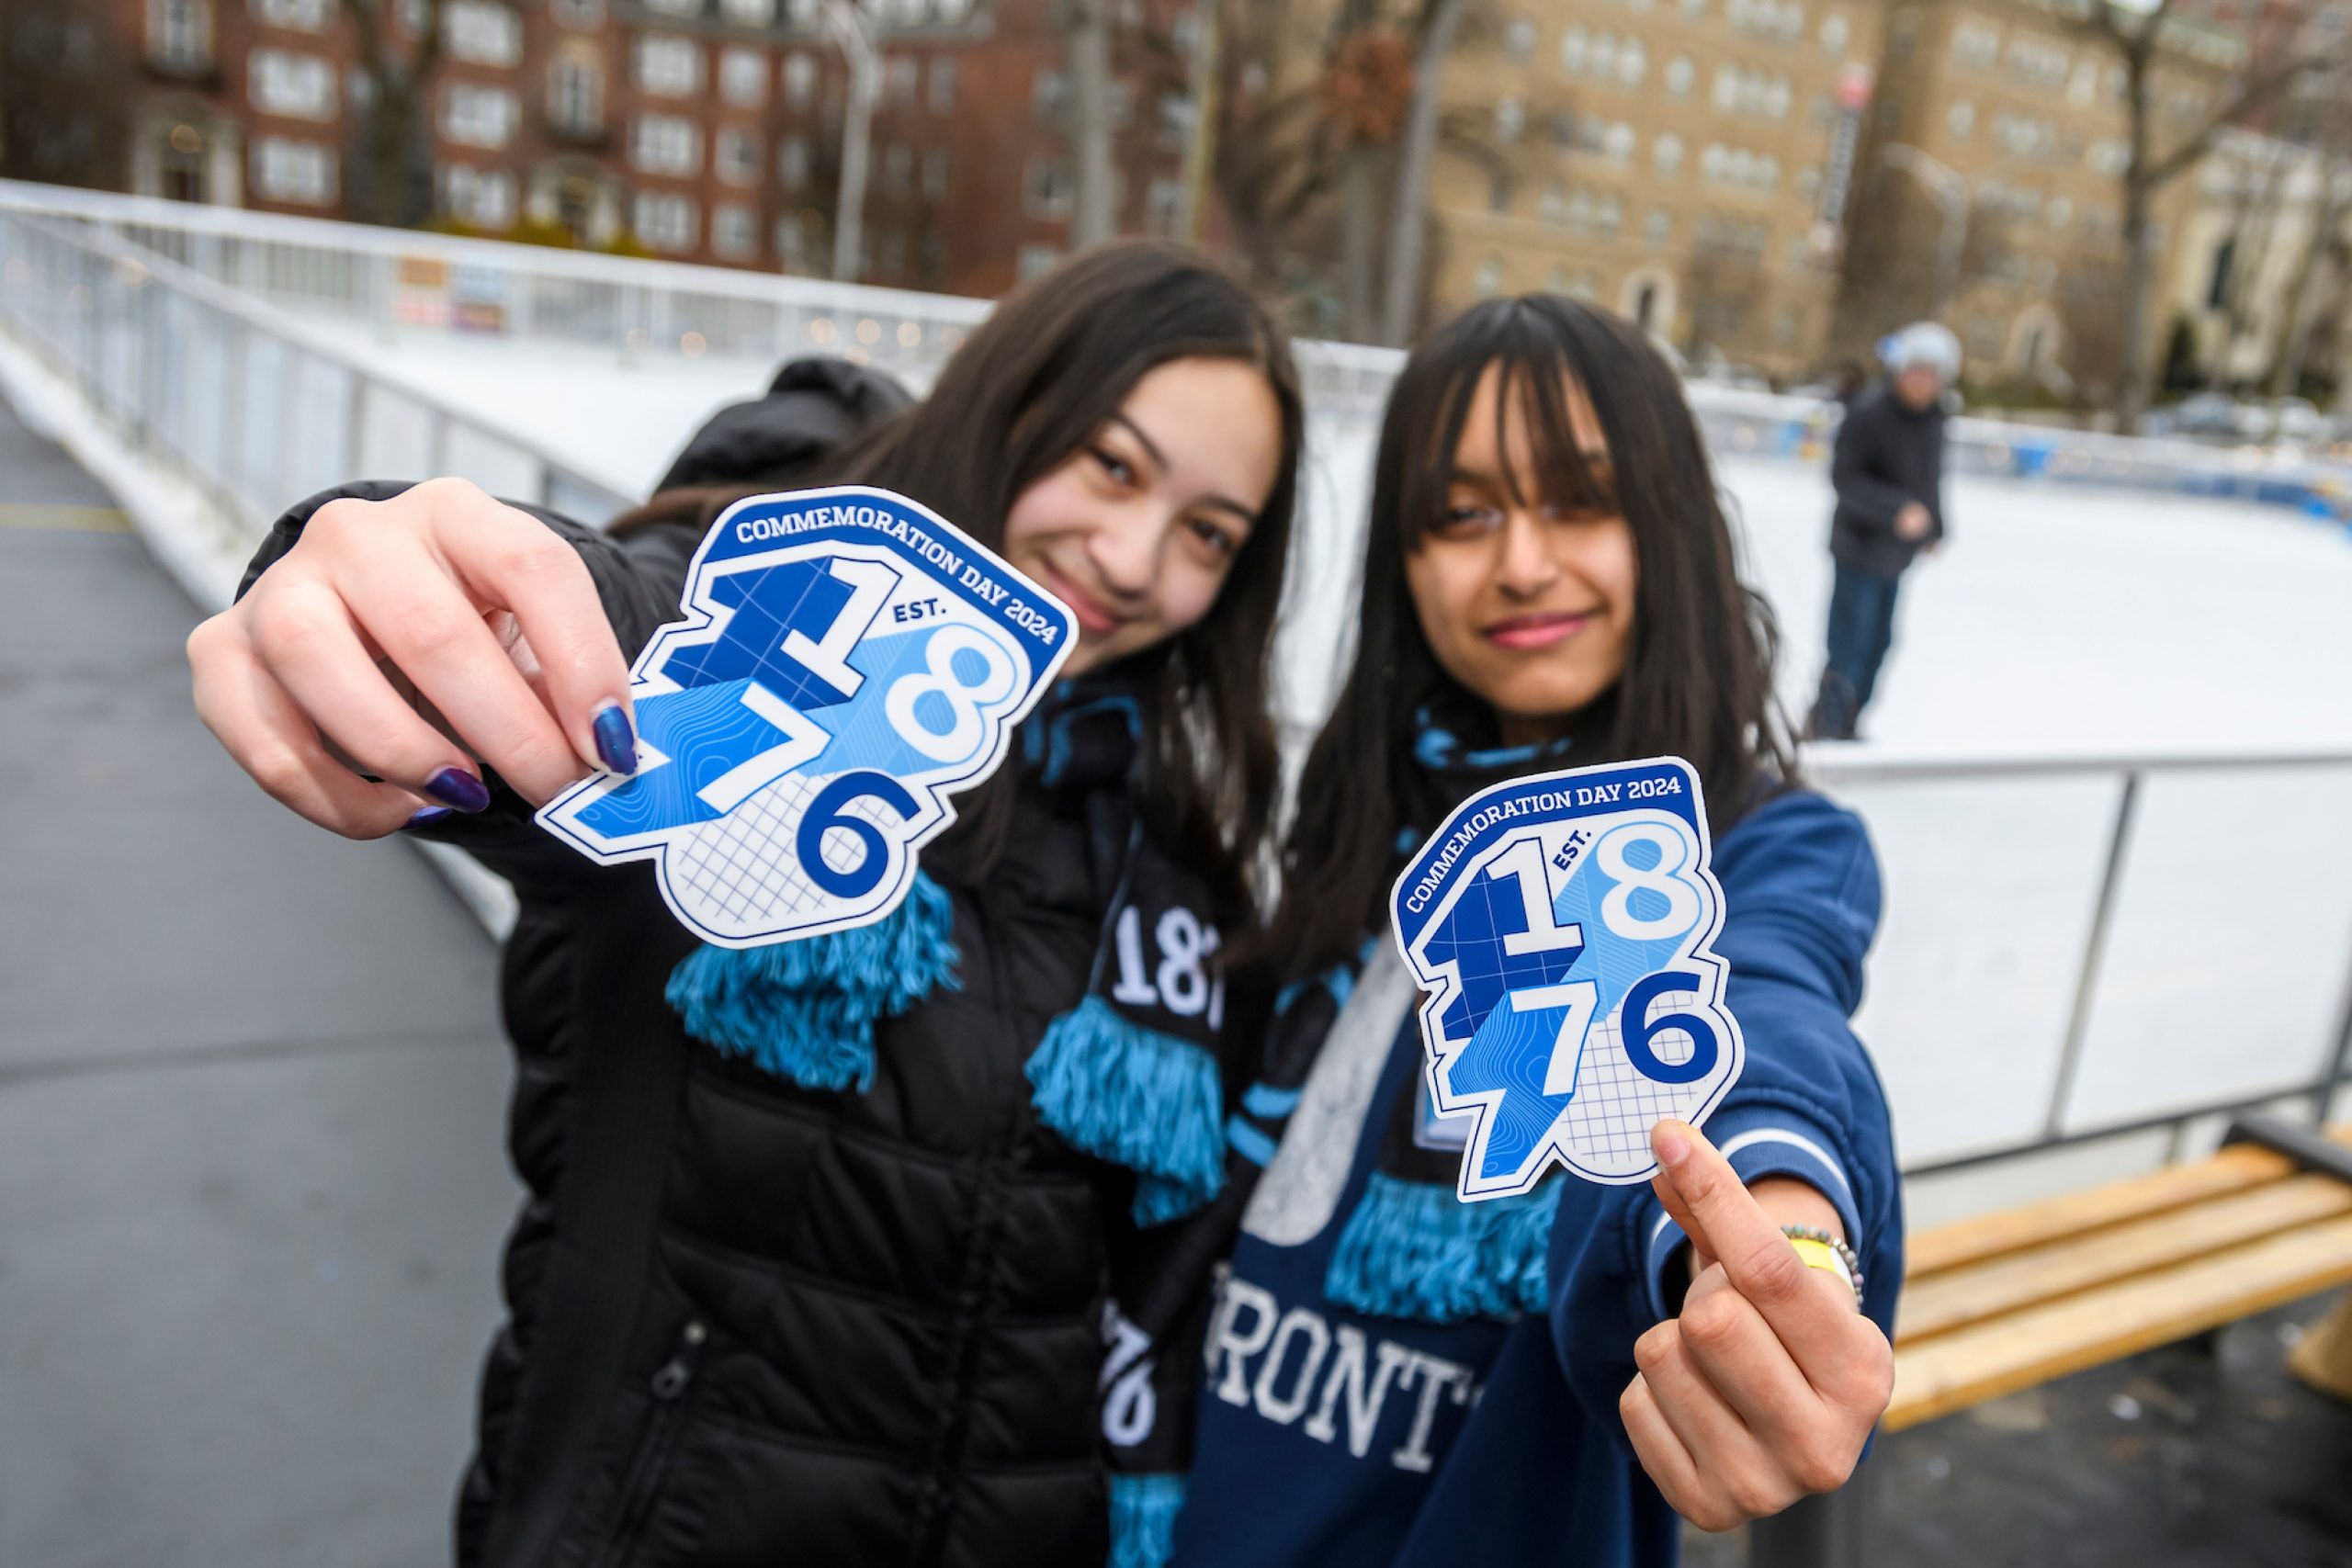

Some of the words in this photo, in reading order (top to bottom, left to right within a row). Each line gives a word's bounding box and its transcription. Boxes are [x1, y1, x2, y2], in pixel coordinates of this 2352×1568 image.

[736, 506, 964, 576] COMMEMORATION
[958, 565, 1010, 607] DAY
[1004, 598, 1059, 646] 2024
[893, 597, 947, 623] EST.
[1406, 791, 1572, 914] COMMEMORATION
[1577, 783, 1623, 806] DAY
[1628, 776, 1682, 800] 2024
[1552, 829, 1592, 871] EST.
